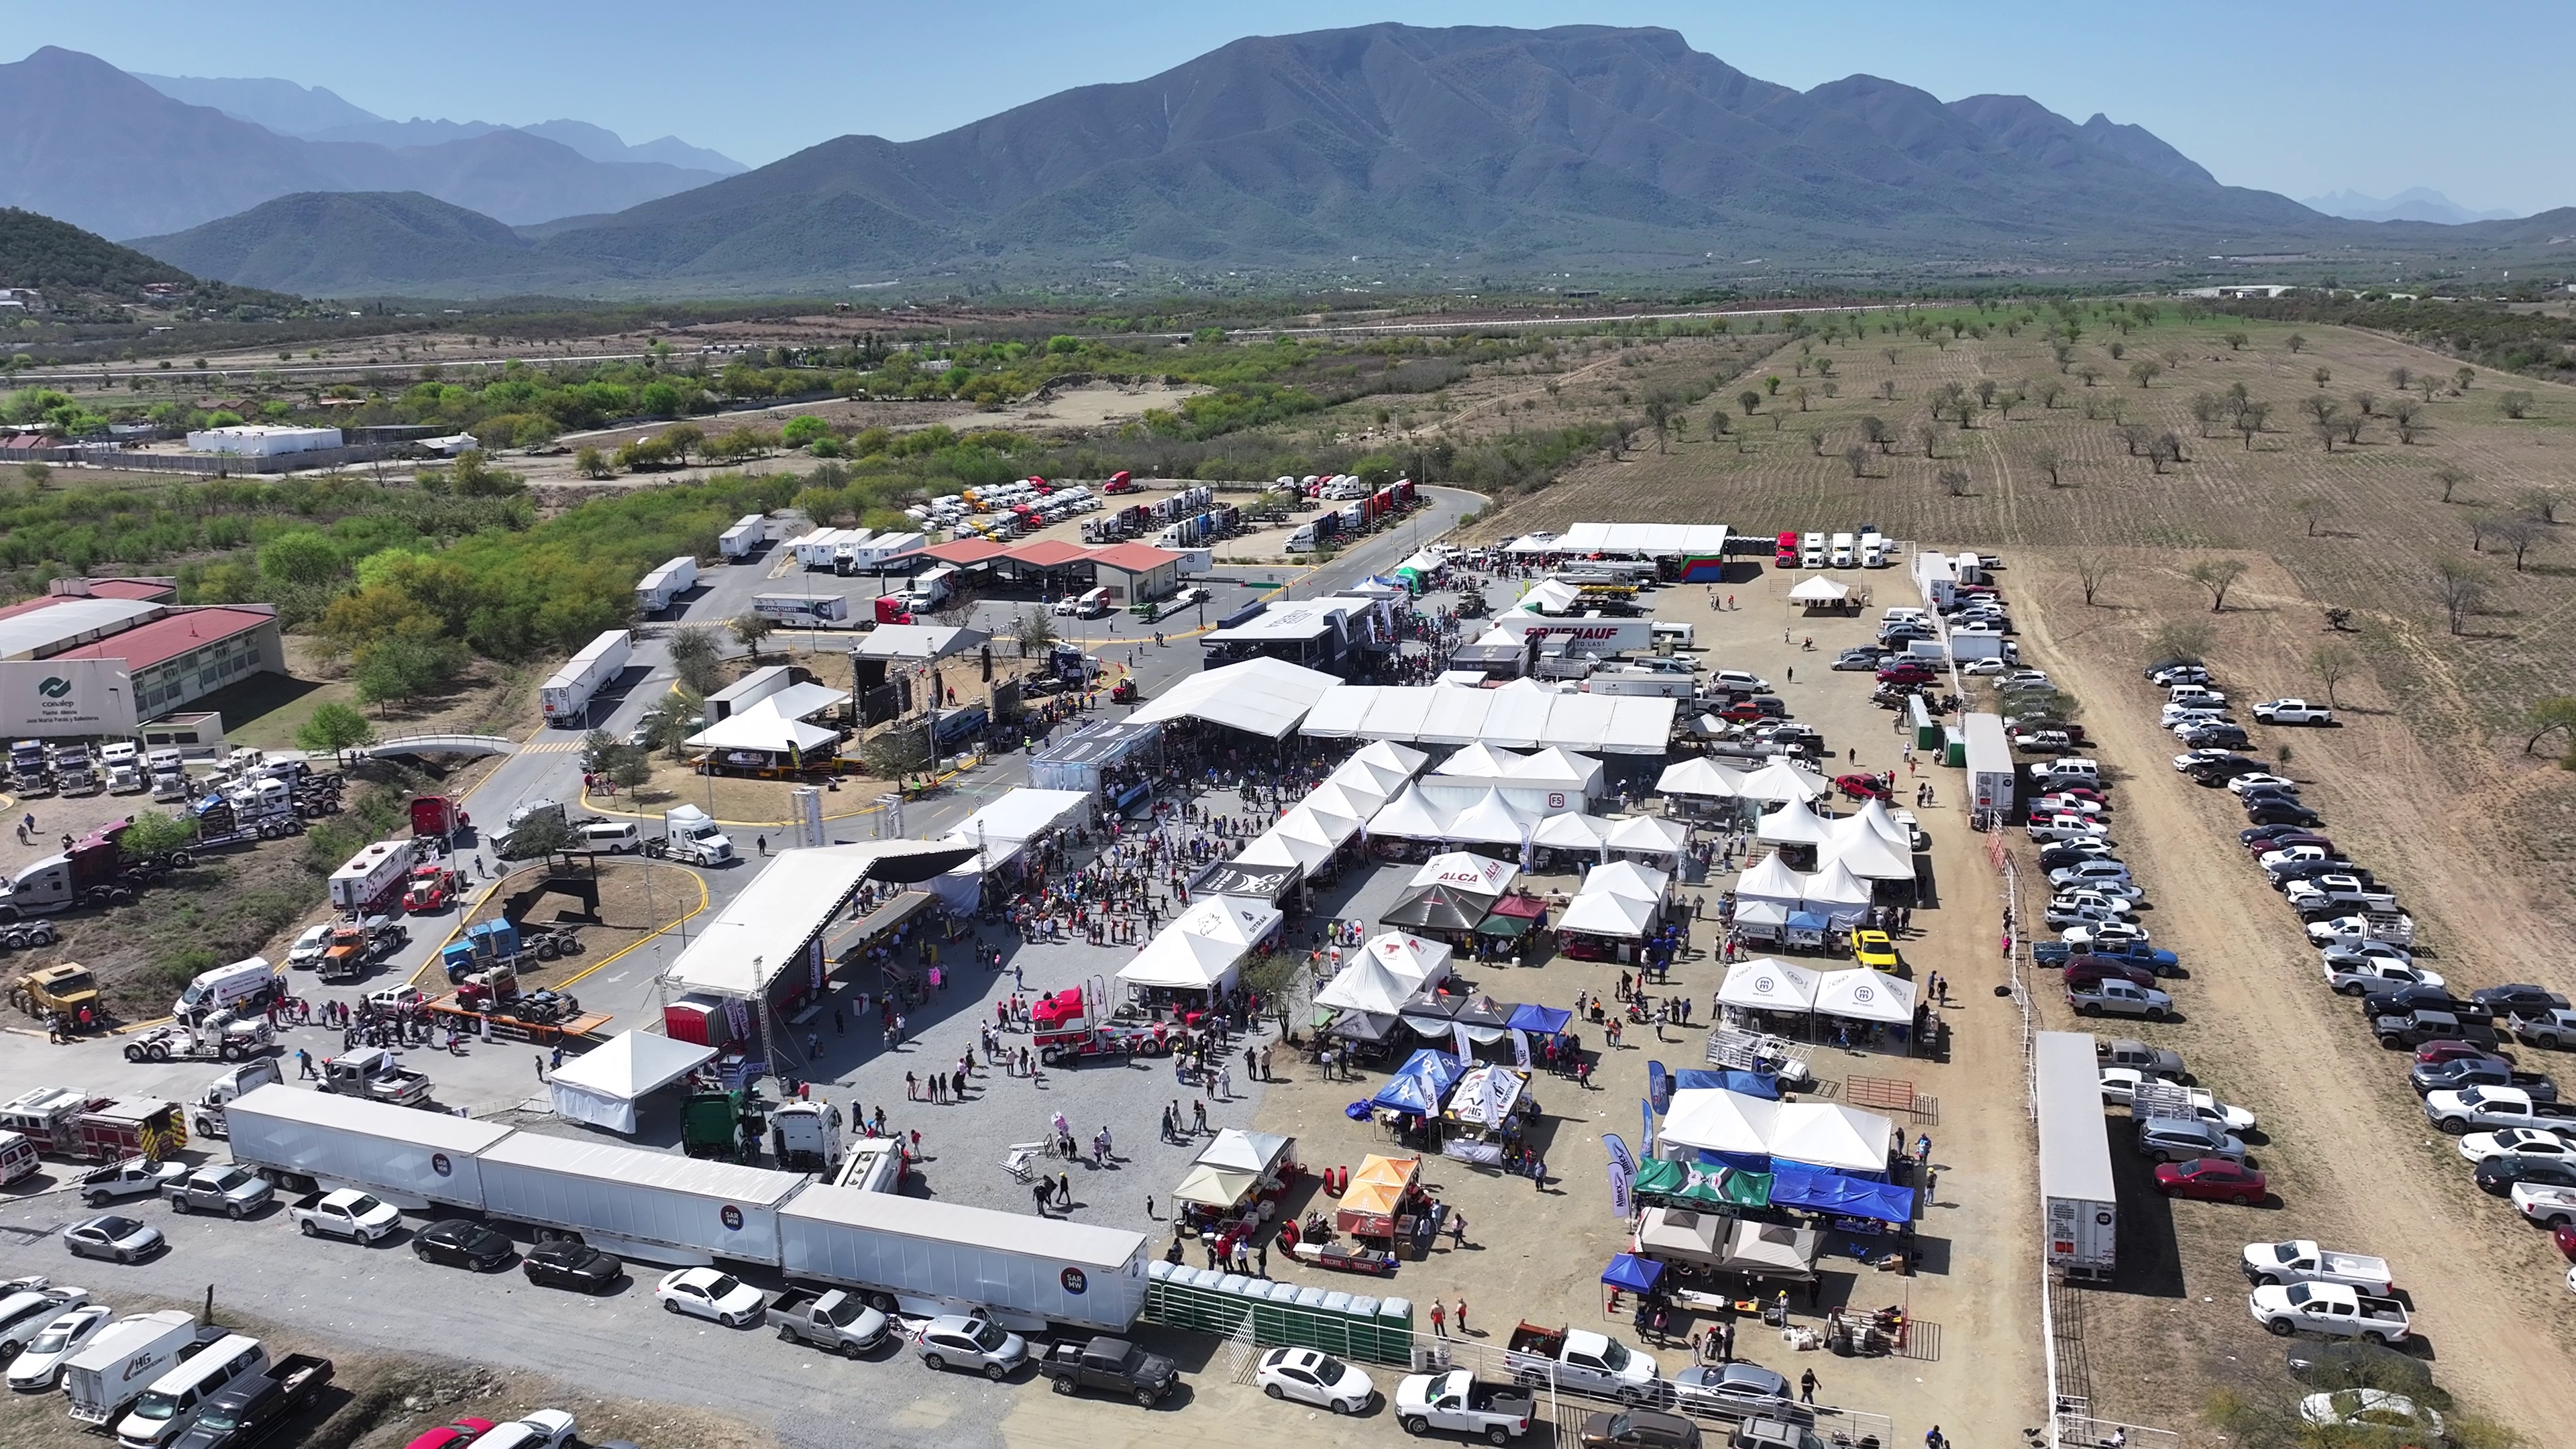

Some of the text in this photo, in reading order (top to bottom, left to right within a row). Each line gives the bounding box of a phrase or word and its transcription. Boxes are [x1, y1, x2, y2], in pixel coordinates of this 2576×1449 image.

[42, 700, 74, 708] conalep
[1485, 861, 1501, 879] ALCA
[1438, 872, 1479, 882] ALCA
[1248, 914, 1269, 933] SITRAK
[1468, 1106, 1483, 1116] HG
[1617, 1153, 1632, 1175] Almex
[1615, 1185, 1623, 1208] Almex
[725, 1211, 739, 1219] SAR
[1323, 1258, 1342, 1266] TECATE
[1354, 1262, 1373, 1270] TECATE
[1067, 1274, 1082, 1282] SAR
[135, 1352, 152, 1369] HG
